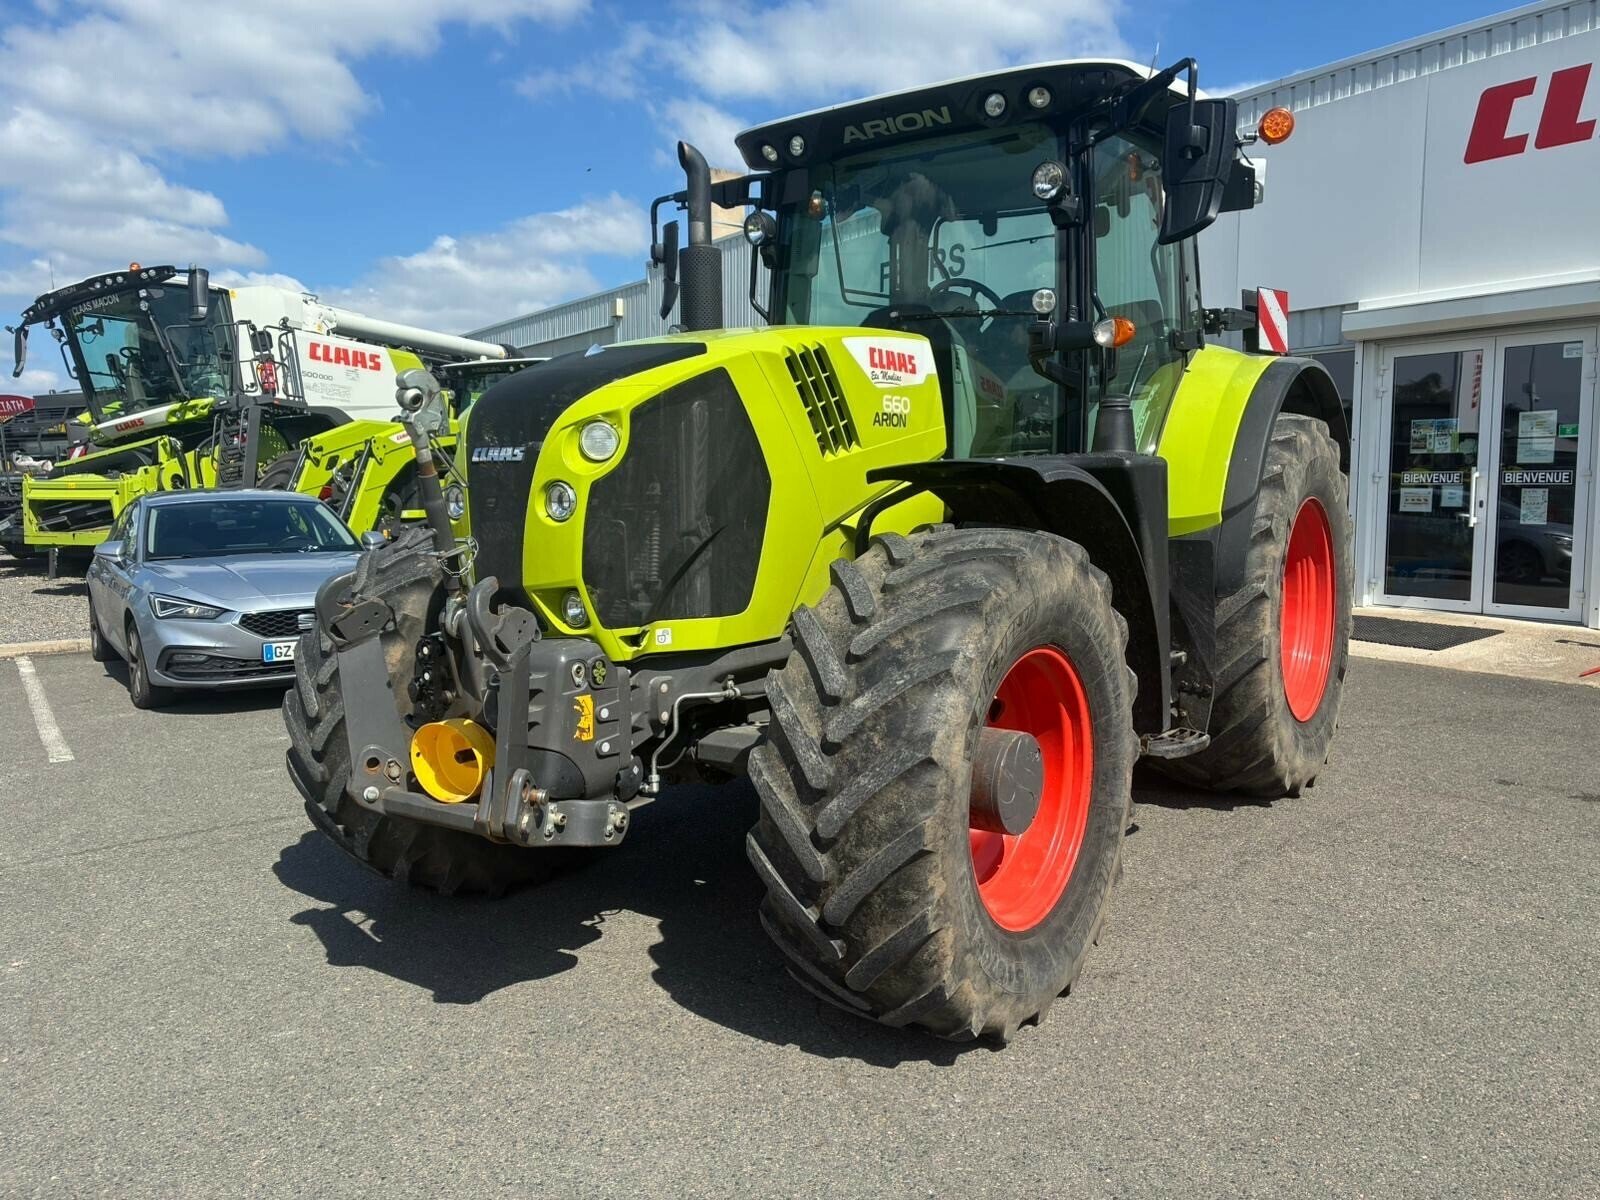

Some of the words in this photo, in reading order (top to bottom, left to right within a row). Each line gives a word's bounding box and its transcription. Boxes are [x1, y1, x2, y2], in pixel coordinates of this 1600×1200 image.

[843, 106, 952, 144] ARION
[309, 342, 382, 371] CLAAS
[869, 346, 917, 375] CLAAS
[0, 400, 25, 416] IATH
[883, 394, 911, 413] 660
[873, 412, 907, 428] ARION
[472, 447, 526, 462] CLAAS
[1403, 472, 1460, 484] BIENVENUE
[1504, 471, 1570, 484] BIENVENUE
